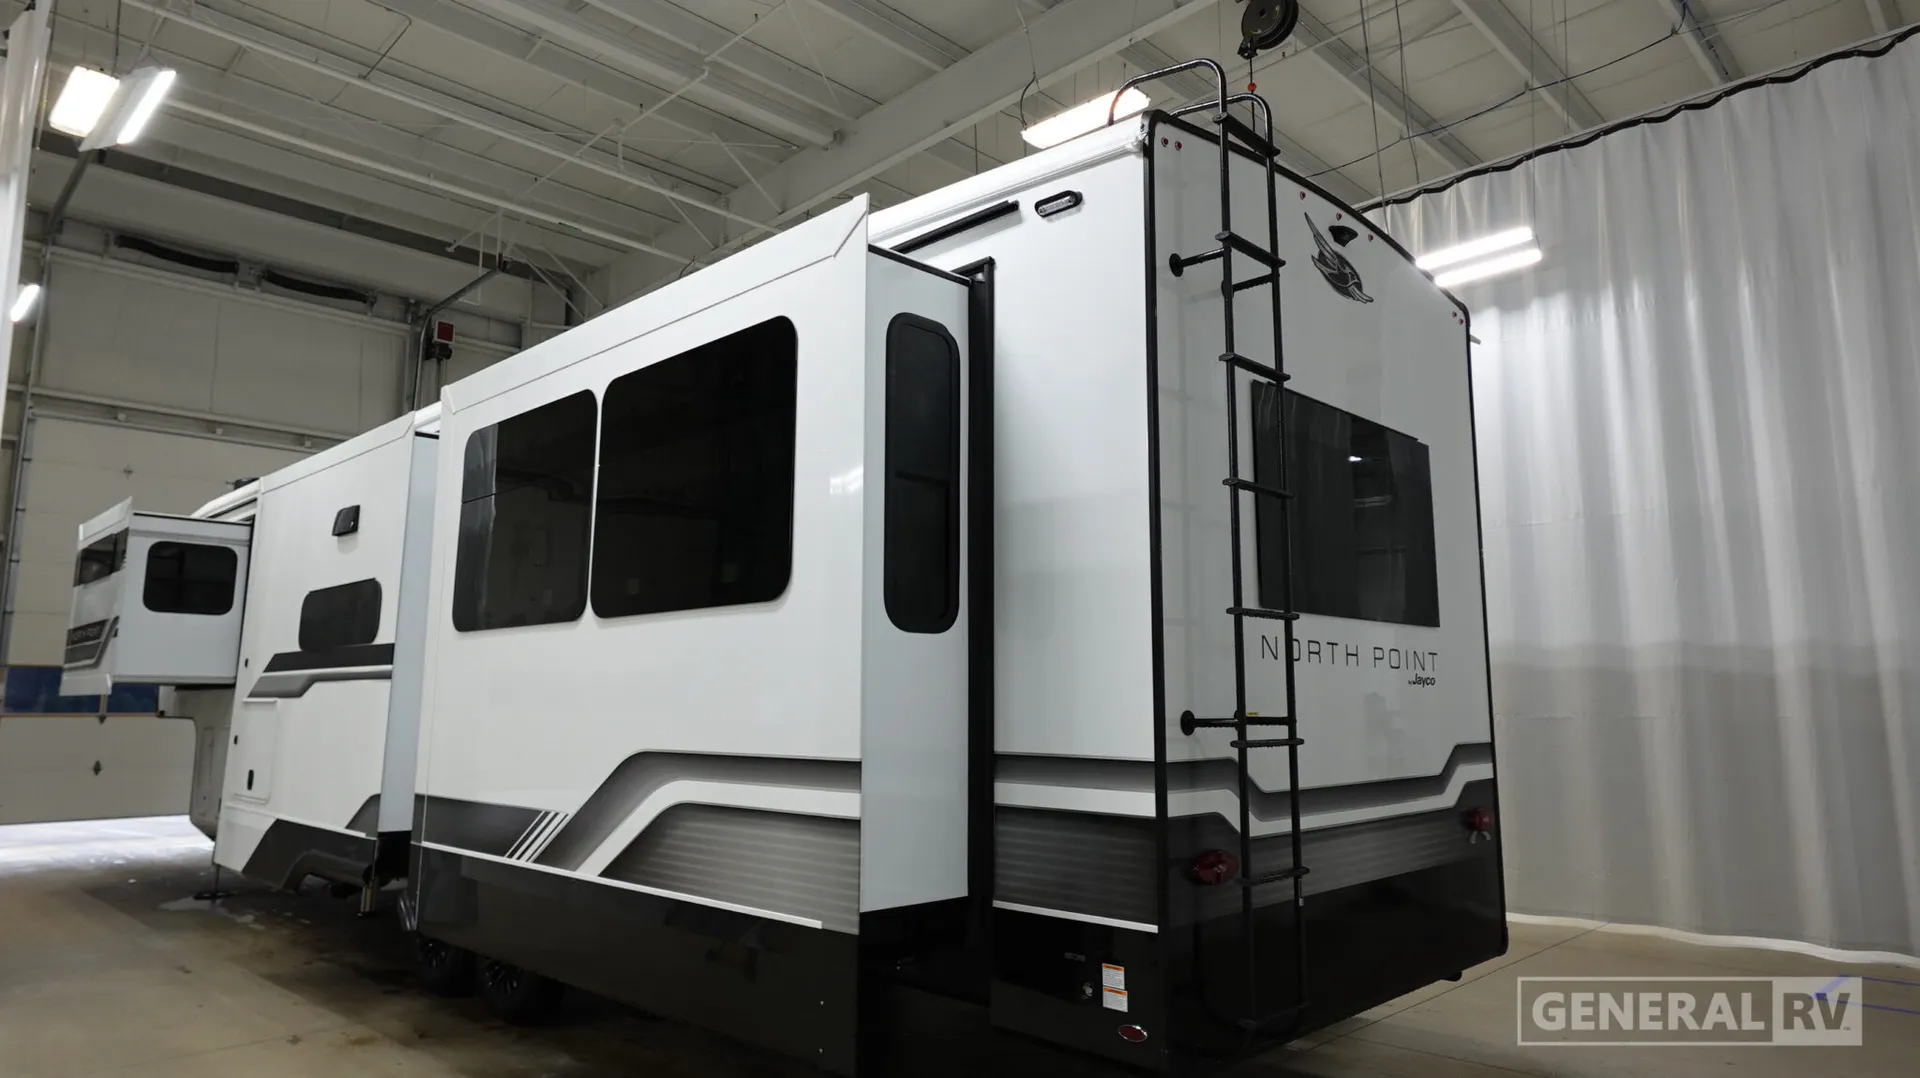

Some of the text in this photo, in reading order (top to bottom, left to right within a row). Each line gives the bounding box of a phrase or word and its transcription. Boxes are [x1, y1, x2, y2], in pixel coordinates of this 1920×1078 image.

[1261, 635, 1438, 672] NORTH POINT
[1412, 673, 1436, 688] Jayco
